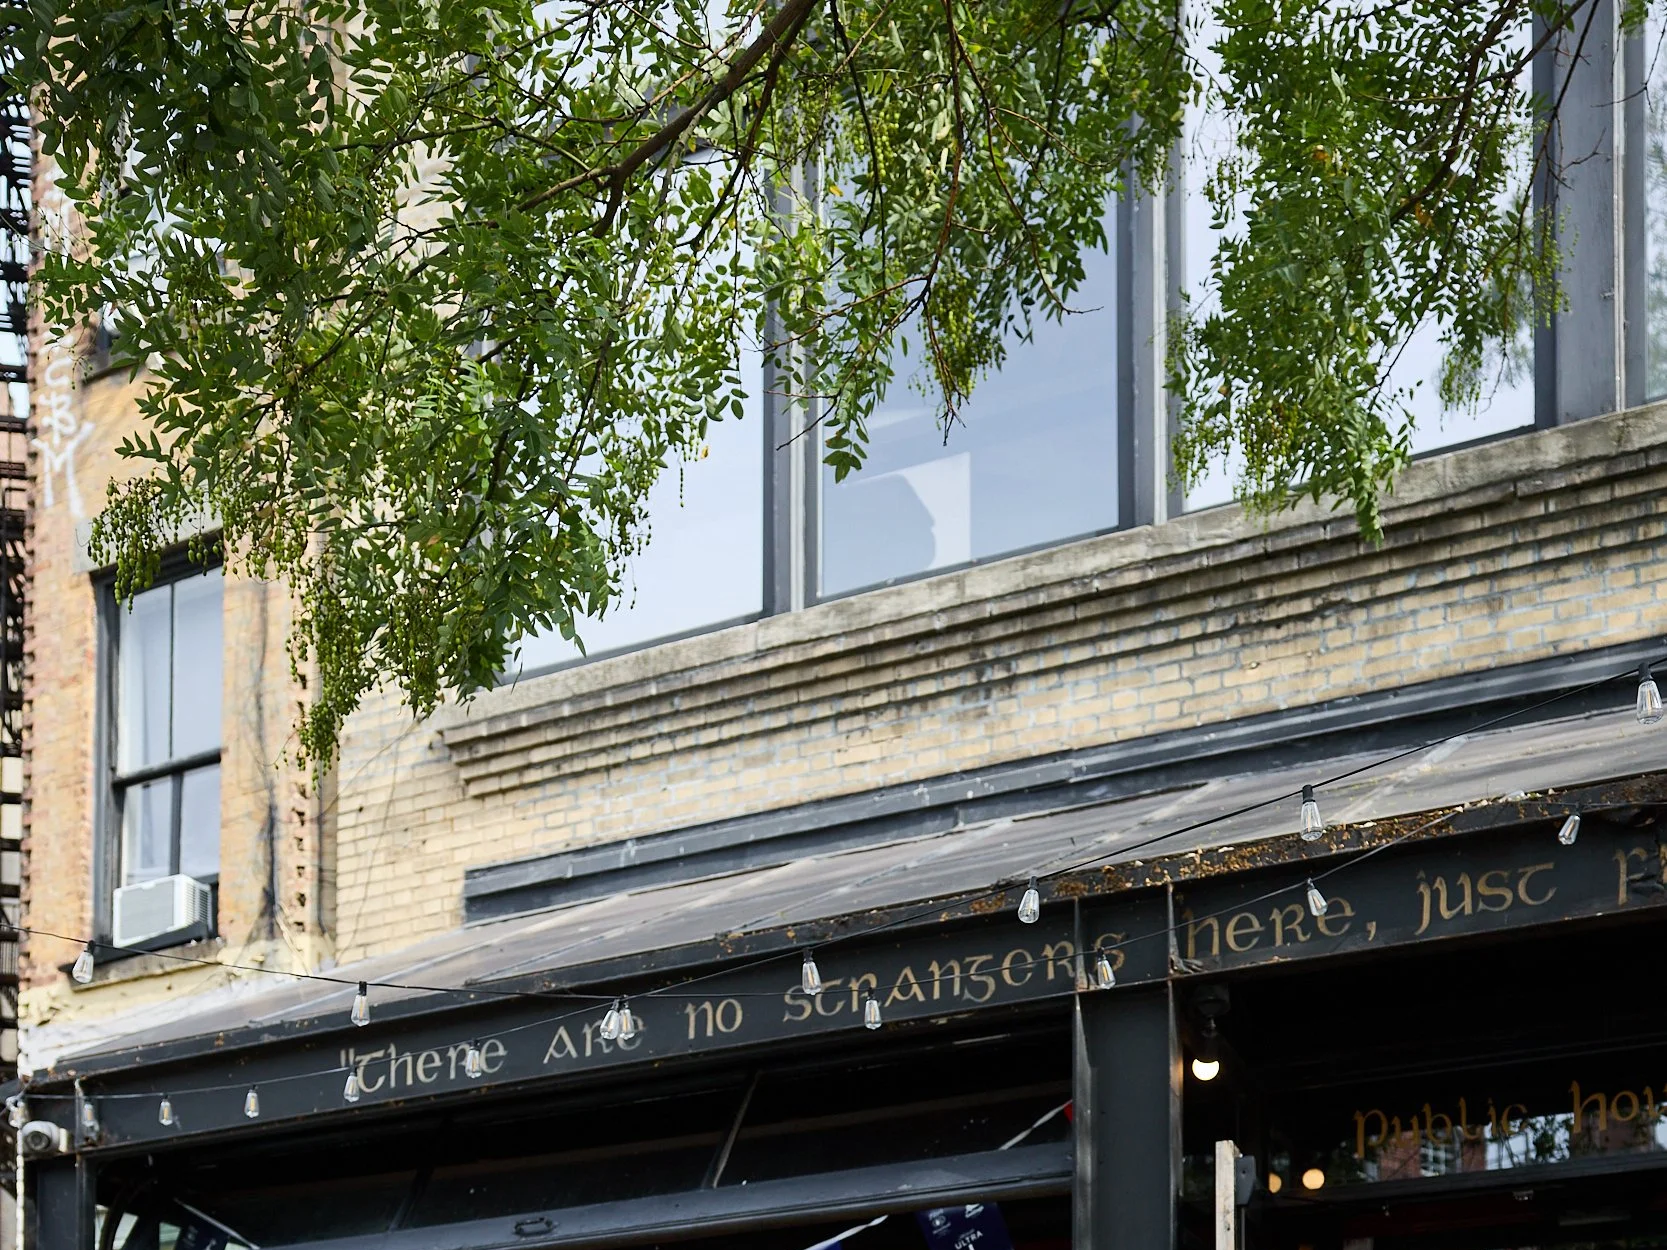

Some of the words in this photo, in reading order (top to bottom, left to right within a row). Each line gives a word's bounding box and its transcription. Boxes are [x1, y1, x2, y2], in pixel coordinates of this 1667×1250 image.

[684, 998, 743, 1040] no
[1414, 862, 1558, 936] just
[1569, 1080, 1667, 1134] hou
